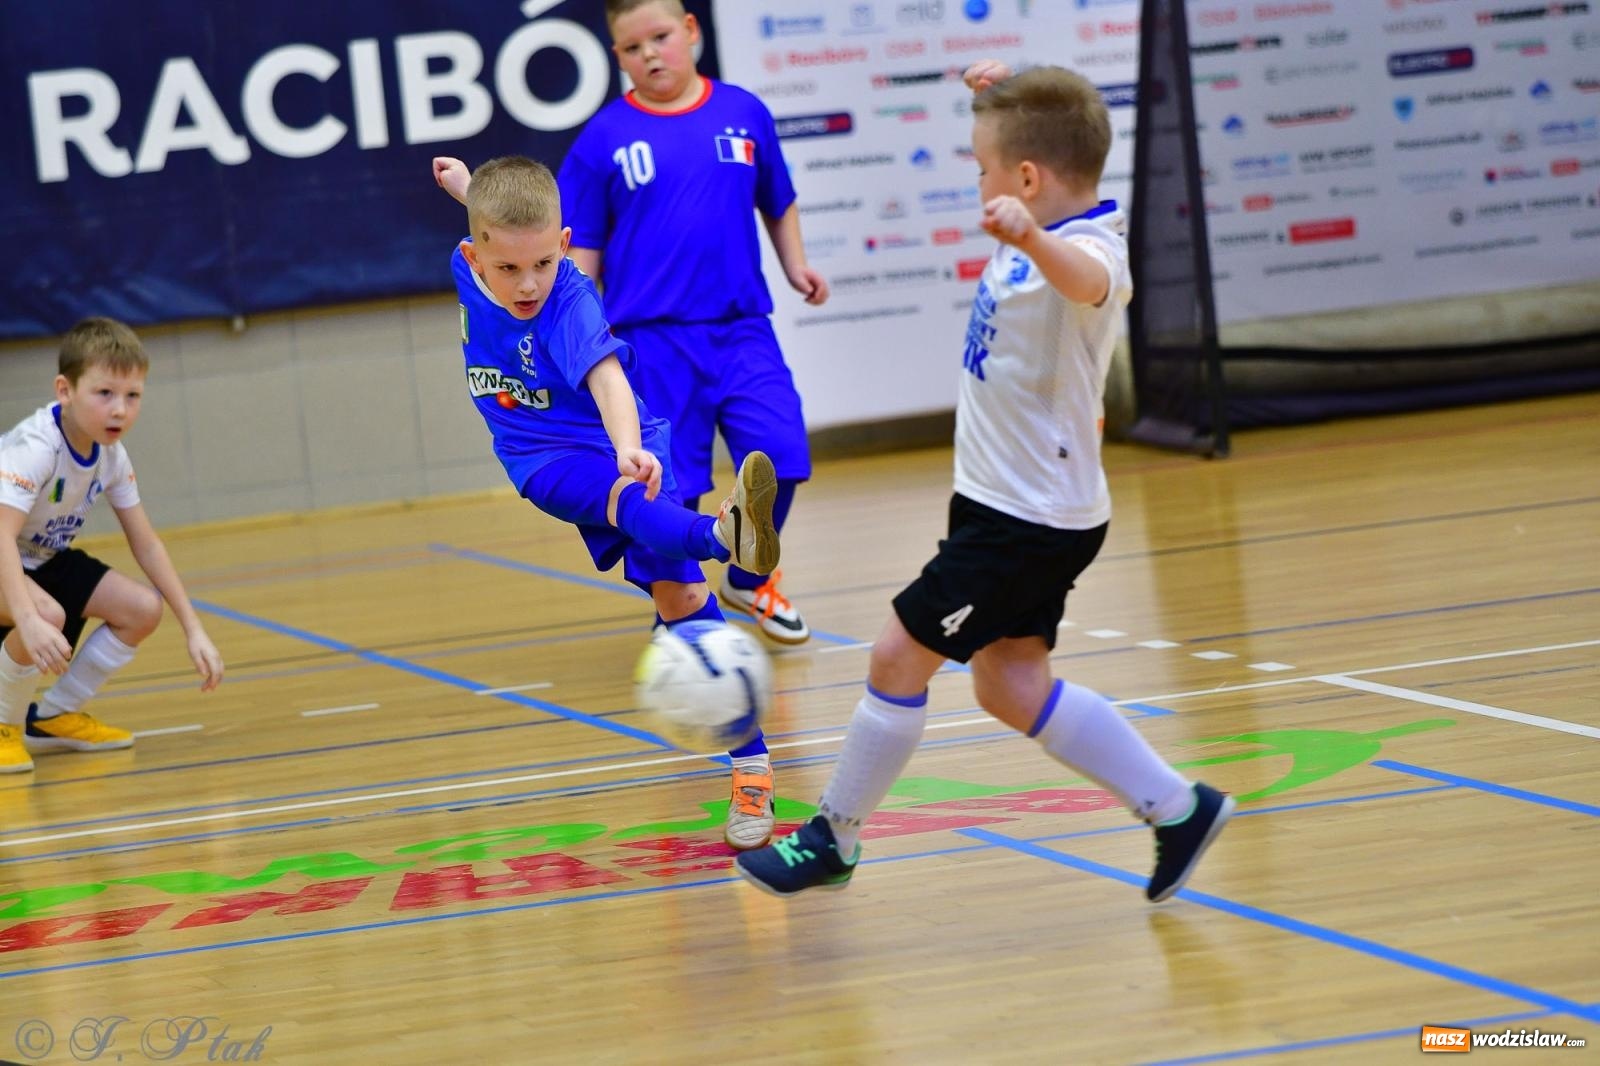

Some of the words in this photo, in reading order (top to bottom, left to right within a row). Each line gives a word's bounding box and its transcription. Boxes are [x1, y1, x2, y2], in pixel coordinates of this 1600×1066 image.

[27, 0, 704, 184] RACIBÓ
[612, 140, 657, 192] 10
[940, 603, 975, 638] 4
